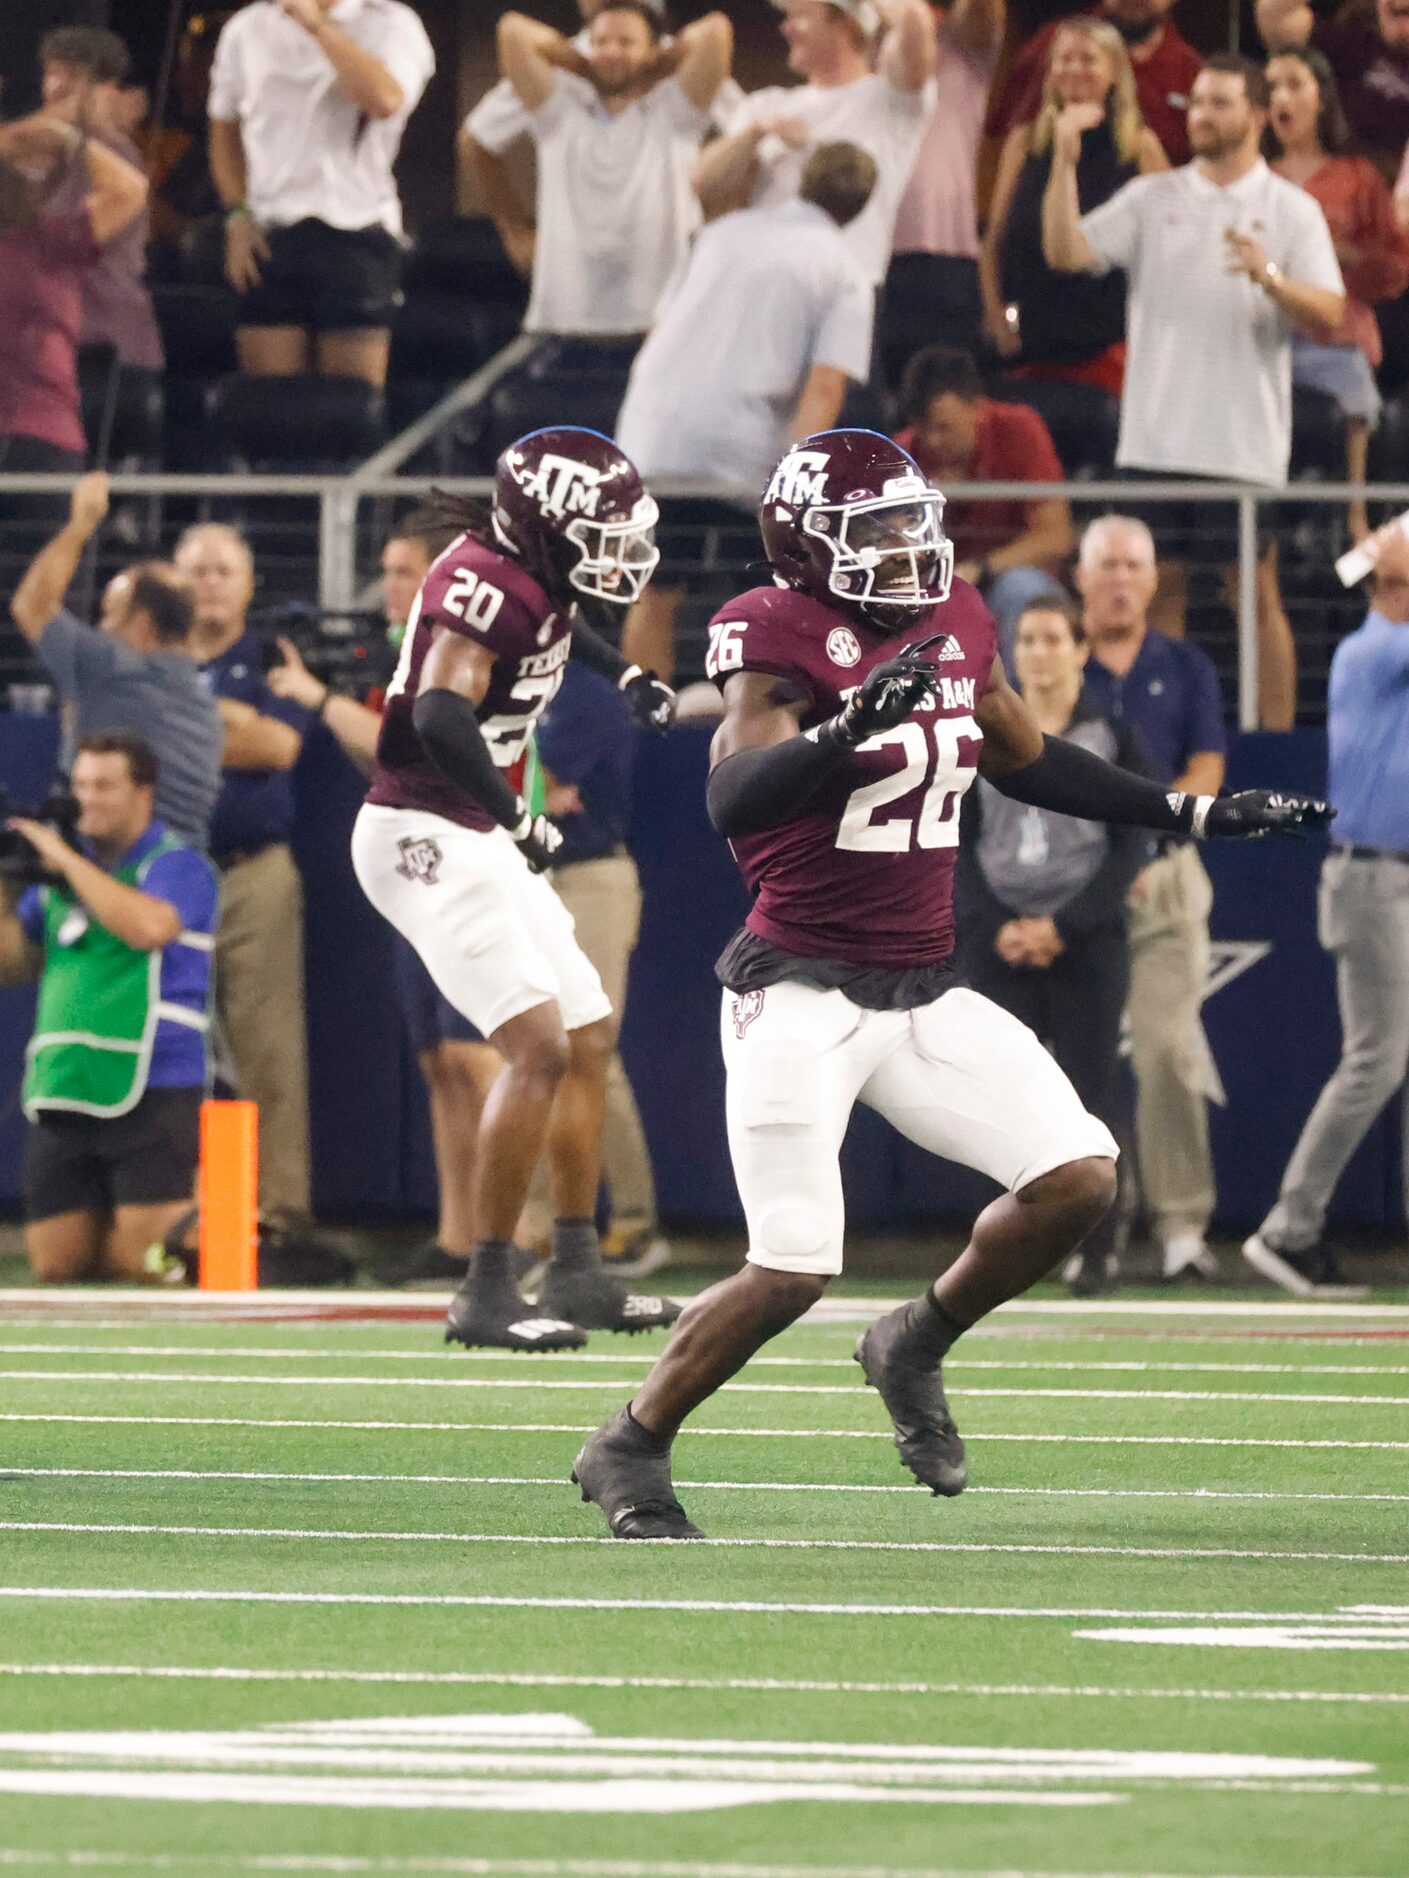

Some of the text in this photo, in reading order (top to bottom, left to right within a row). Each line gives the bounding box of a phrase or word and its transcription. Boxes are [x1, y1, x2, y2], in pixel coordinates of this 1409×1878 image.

[443, 568, 505, 633] 20
[706, 622, 749, 680] 26
[828, 629, 860, 665] SEC
[940, 677, 976, 710] A&M
[835, 716, 984, 852] 26
